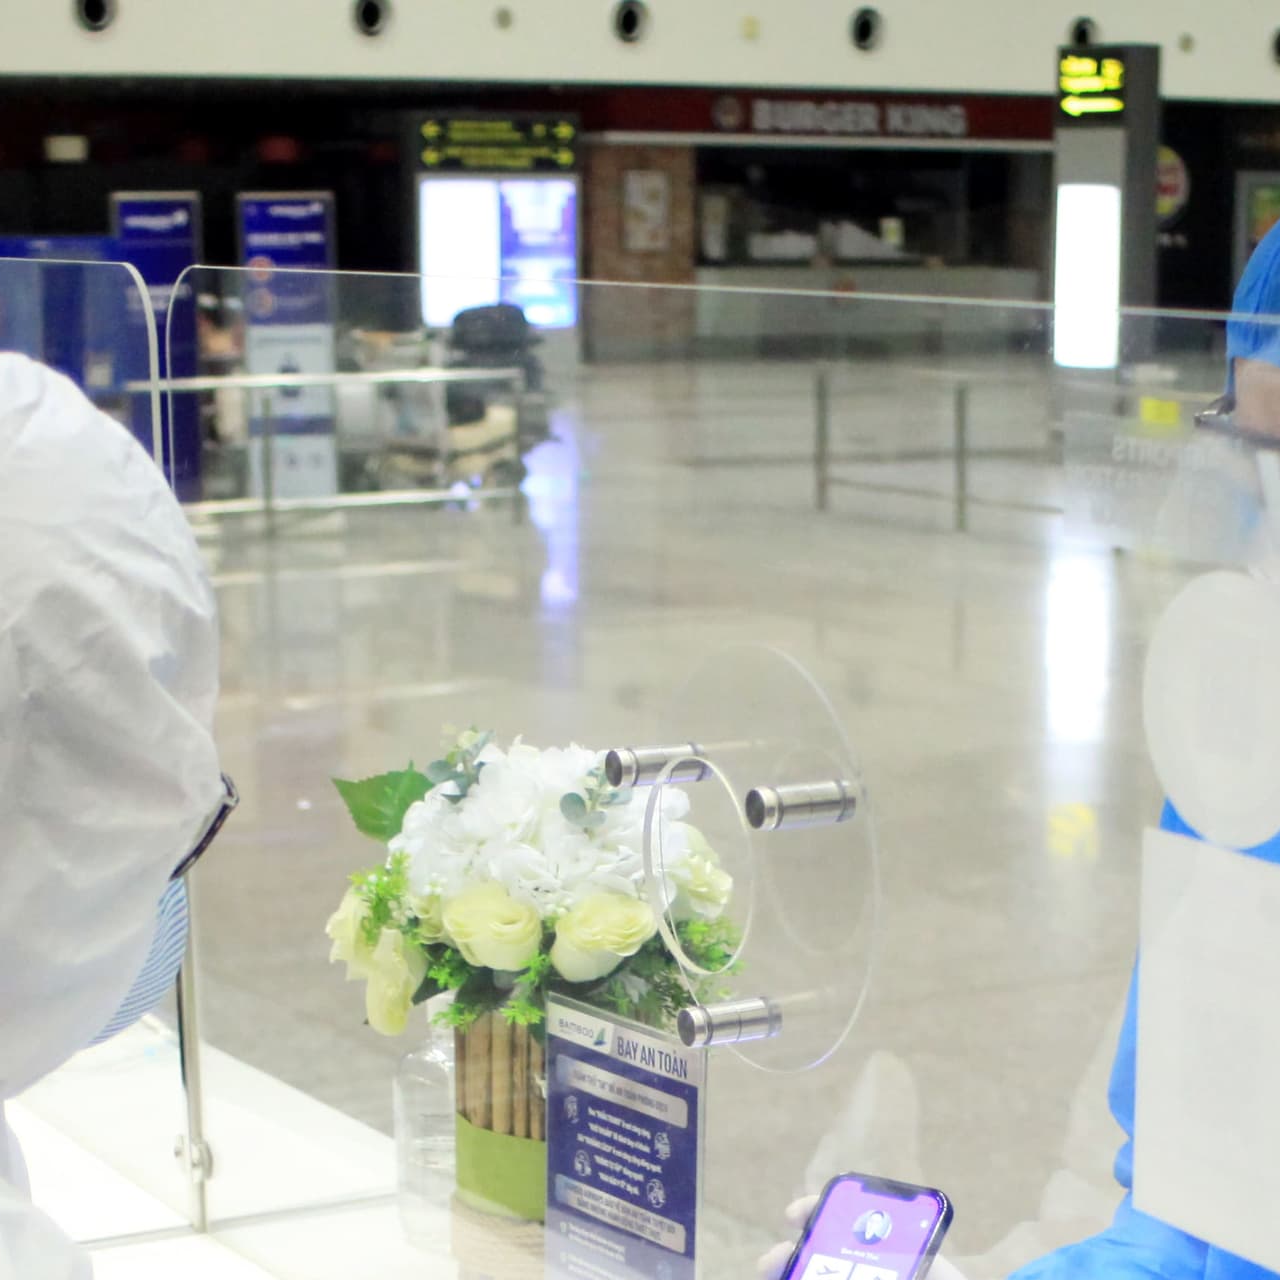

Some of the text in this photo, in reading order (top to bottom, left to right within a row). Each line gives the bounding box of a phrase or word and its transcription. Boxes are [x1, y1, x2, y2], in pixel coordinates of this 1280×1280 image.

[752, 98, 967, 135] BURGER KING
[617, 1036, 639, 1061] BAY
[640, 1045, 656, 1068] AN
